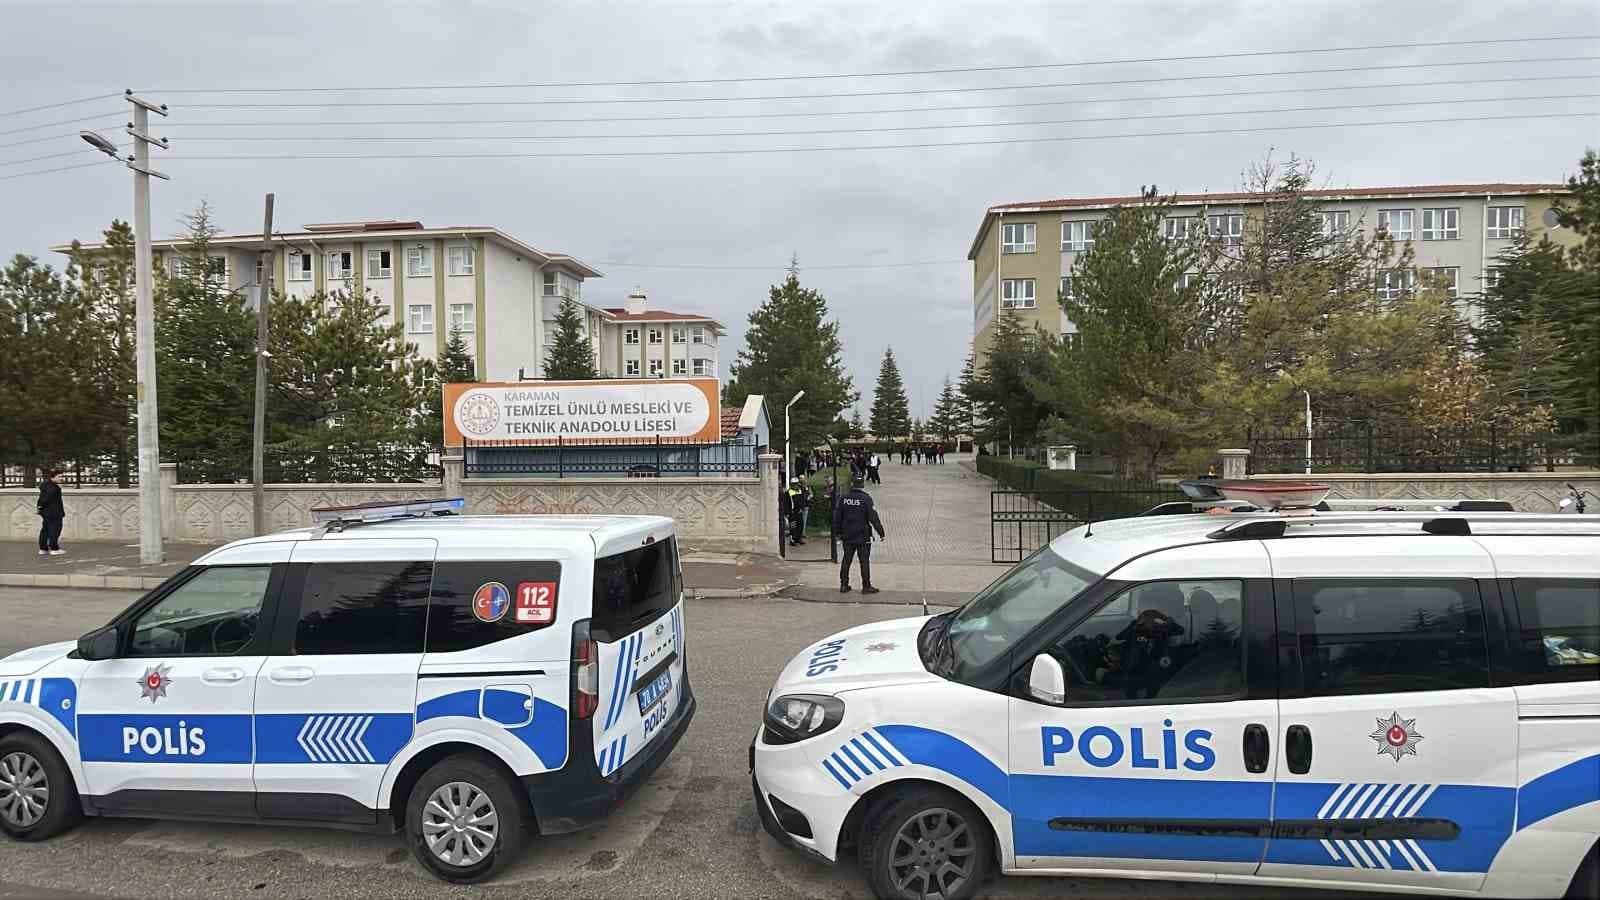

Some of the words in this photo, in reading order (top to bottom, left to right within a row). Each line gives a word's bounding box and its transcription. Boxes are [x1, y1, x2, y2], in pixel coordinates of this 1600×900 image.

[505, 392, 560, 401] KARAMAN
[505, 402, 564, 416] TEMİZEL
[568, 400, 606, 415] ÜNLÜ
[611, 400, 670, 414] MESLEKİ
[674, 402, 693, 413] VE
[505, 419, 556, 434] TEKNİK
[559, 421, 630, 432] ANADOLU
[635, 417, 676, 432] LİSESİ
[523, 586, 549, 606] 112
[123, 719, 206, 756] POLİS
[1041, 718, 1216, 771] POLİS
